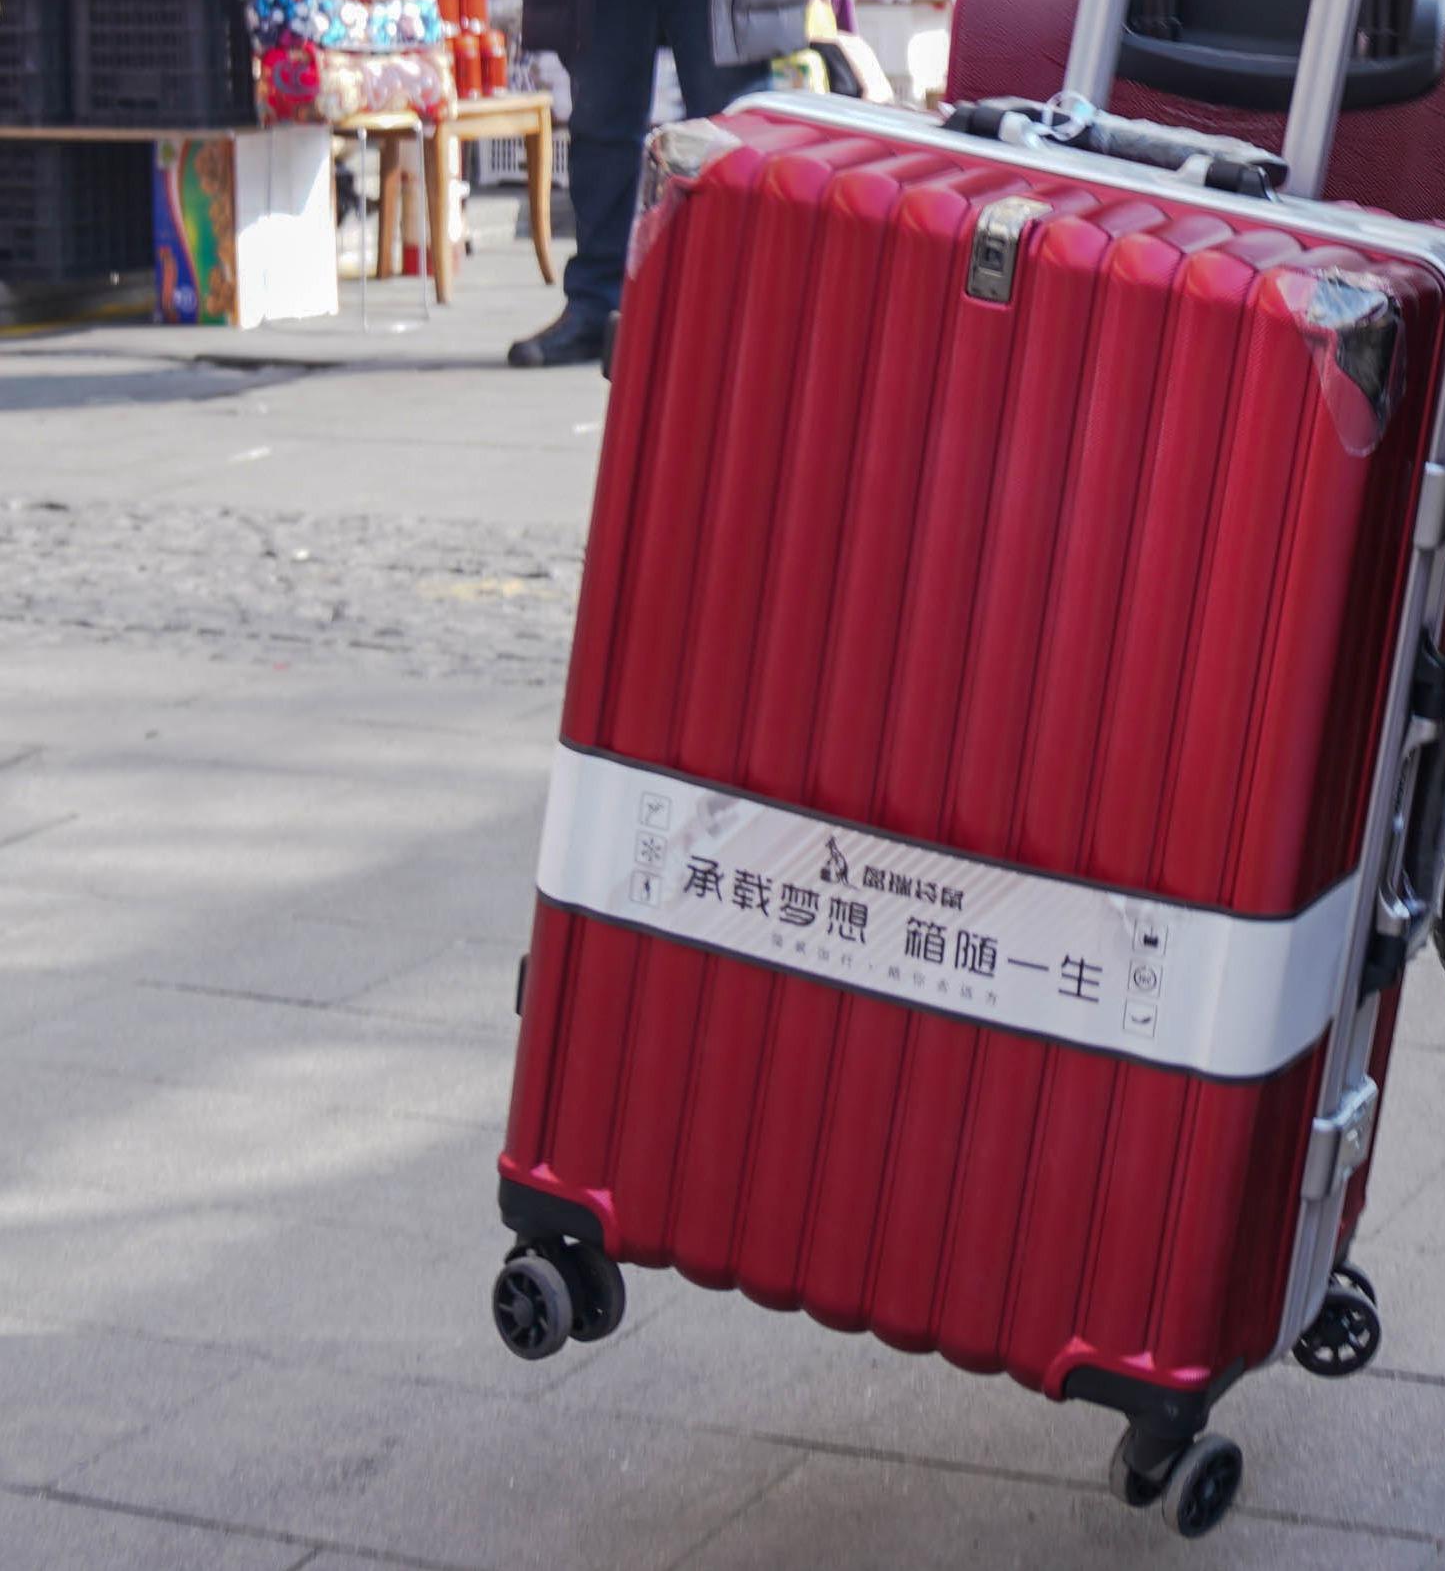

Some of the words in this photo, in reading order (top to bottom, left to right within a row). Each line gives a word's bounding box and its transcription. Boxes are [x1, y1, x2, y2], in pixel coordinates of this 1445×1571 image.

[683, 854, 869, 945] 承载梦想
[903, 915, 1104, 1004] 箱随一生
